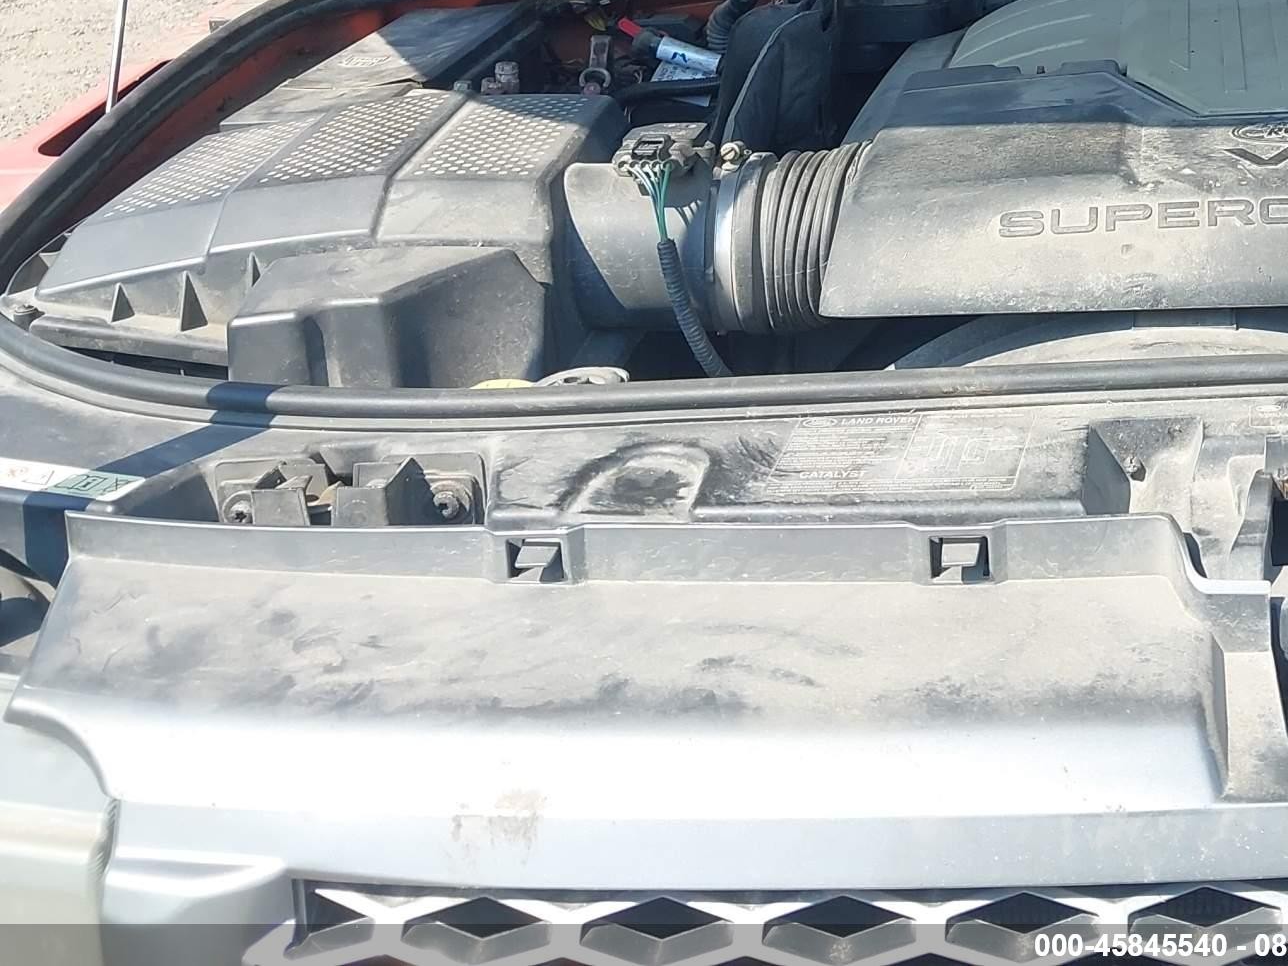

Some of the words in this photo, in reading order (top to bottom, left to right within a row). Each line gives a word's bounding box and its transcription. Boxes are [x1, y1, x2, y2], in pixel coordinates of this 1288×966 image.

[841, 417, 873, 426] LAND
[875, 416, 917, 425] ROVER
[799, 470, 867, 479] CATALYST
